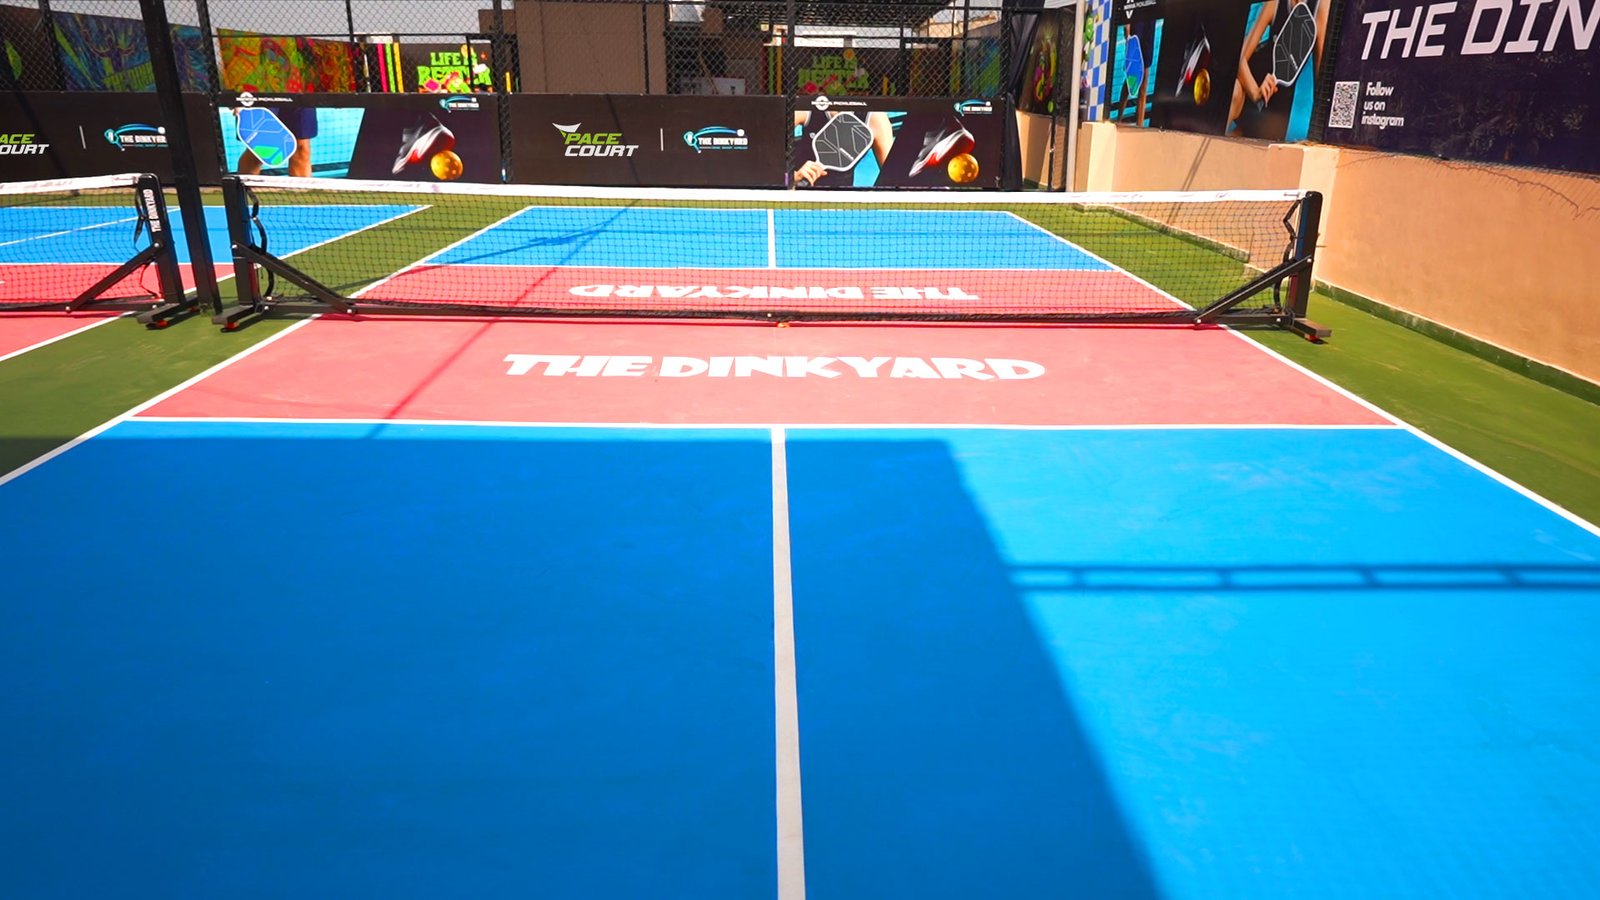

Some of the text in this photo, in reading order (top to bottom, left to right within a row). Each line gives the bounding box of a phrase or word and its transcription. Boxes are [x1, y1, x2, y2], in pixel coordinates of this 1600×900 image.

[1361, 0, 1600, 60] THE DIN
[430, 52, 462, 66] LIFE
[1366, 81, 1395, 96] Follow
[1363, 101, 1386, 111] us on
[1361, 111, 1404, 130] instagram
[564, 133, 622, 145] PACE
[564, 144, 639, 157] COURT
[568, 284, 979, 300] THE DINKYARD
[503, 353, 1046, 381] THE DINKYARD
